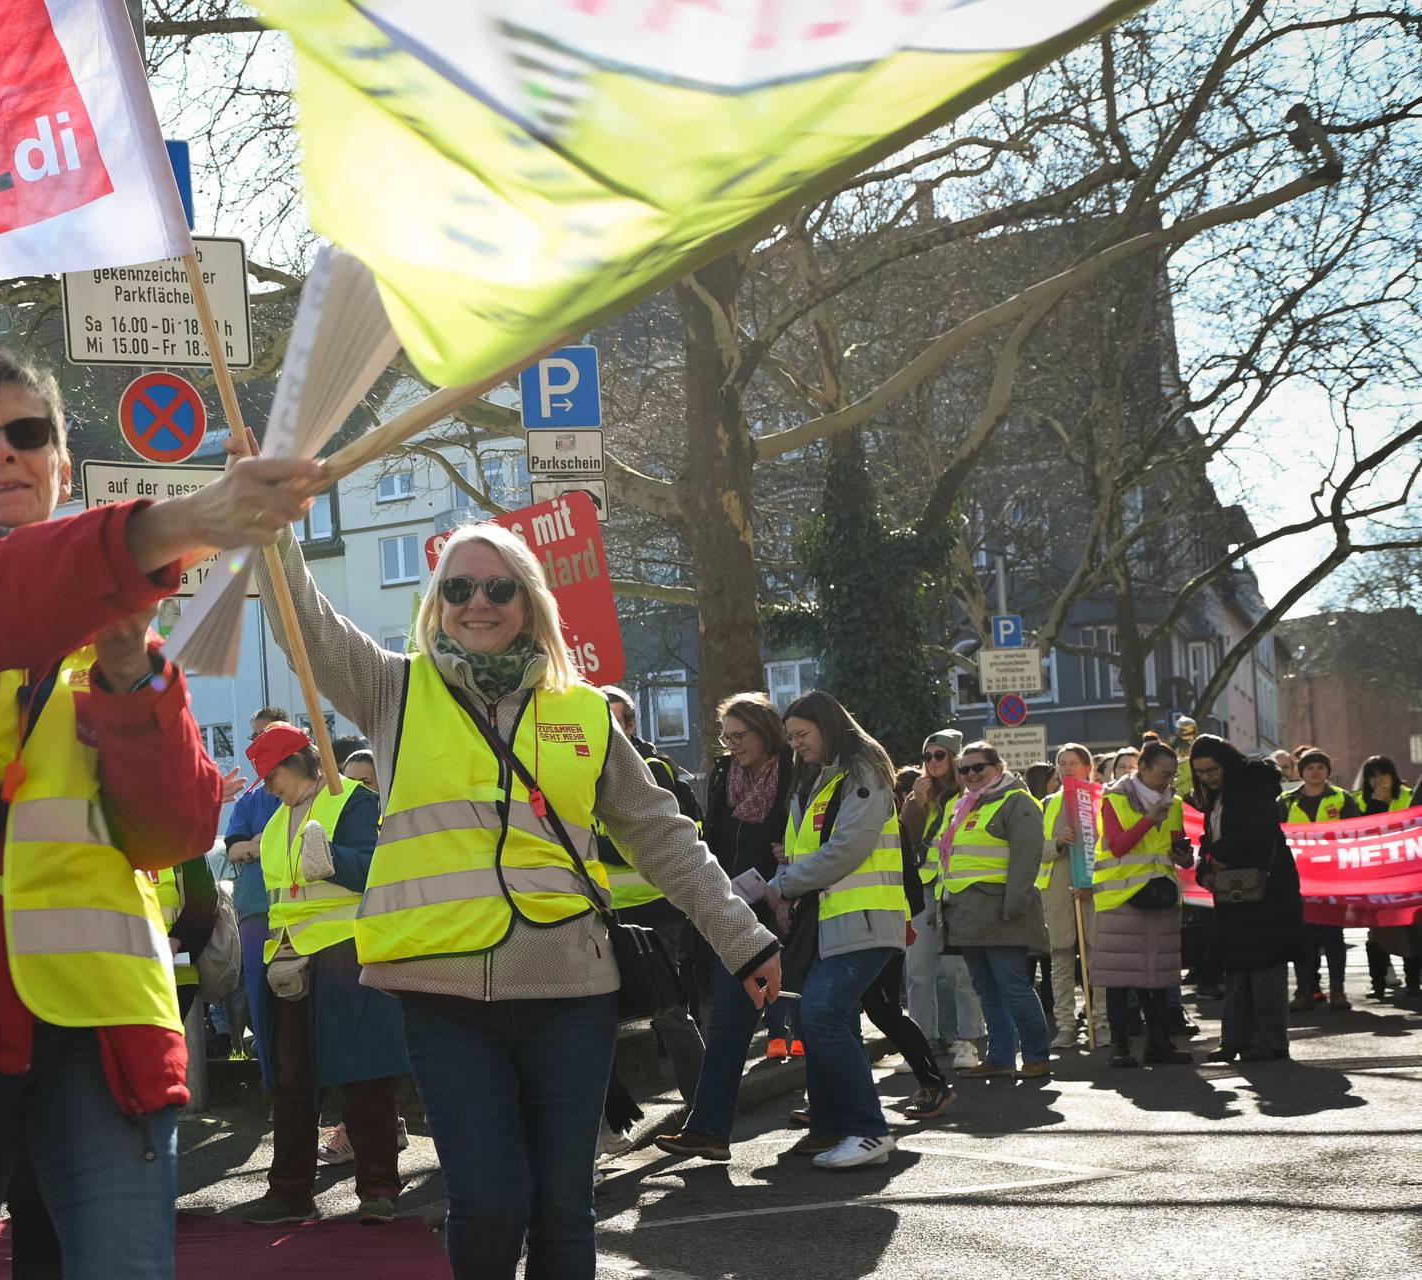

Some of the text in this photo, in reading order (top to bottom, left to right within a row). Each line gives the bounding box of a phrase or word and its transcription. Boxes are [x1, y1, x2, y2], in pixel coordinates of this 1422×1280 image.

[93, 266, 216, 284] gekennzeichner
[85, 316, 102, 332] Sa
[111, 316, 148, 333] 16.00
[162, 318, 176, 335] Di
[184, 319, 219, 335] 18.
[225, 320, 232, 336] h
[86, 337, 103, 353] Mi
[112, 338, 149, 355] 15.00
[162, 340, 177, 356] Fr
[185, 340, 209, 356] 18.
[226, 341, 233, 357] h
[538, 358, 579, 418] P
[531, 455, 601, 470] Parkschein
[108, 478, 128, 494] auf
[137, 479, 158, 495] der
[531, 499, 576, 546] mit
[999, 619, 1015, 644] P
[538, 725, 583, 733] ZUSAMMEN
